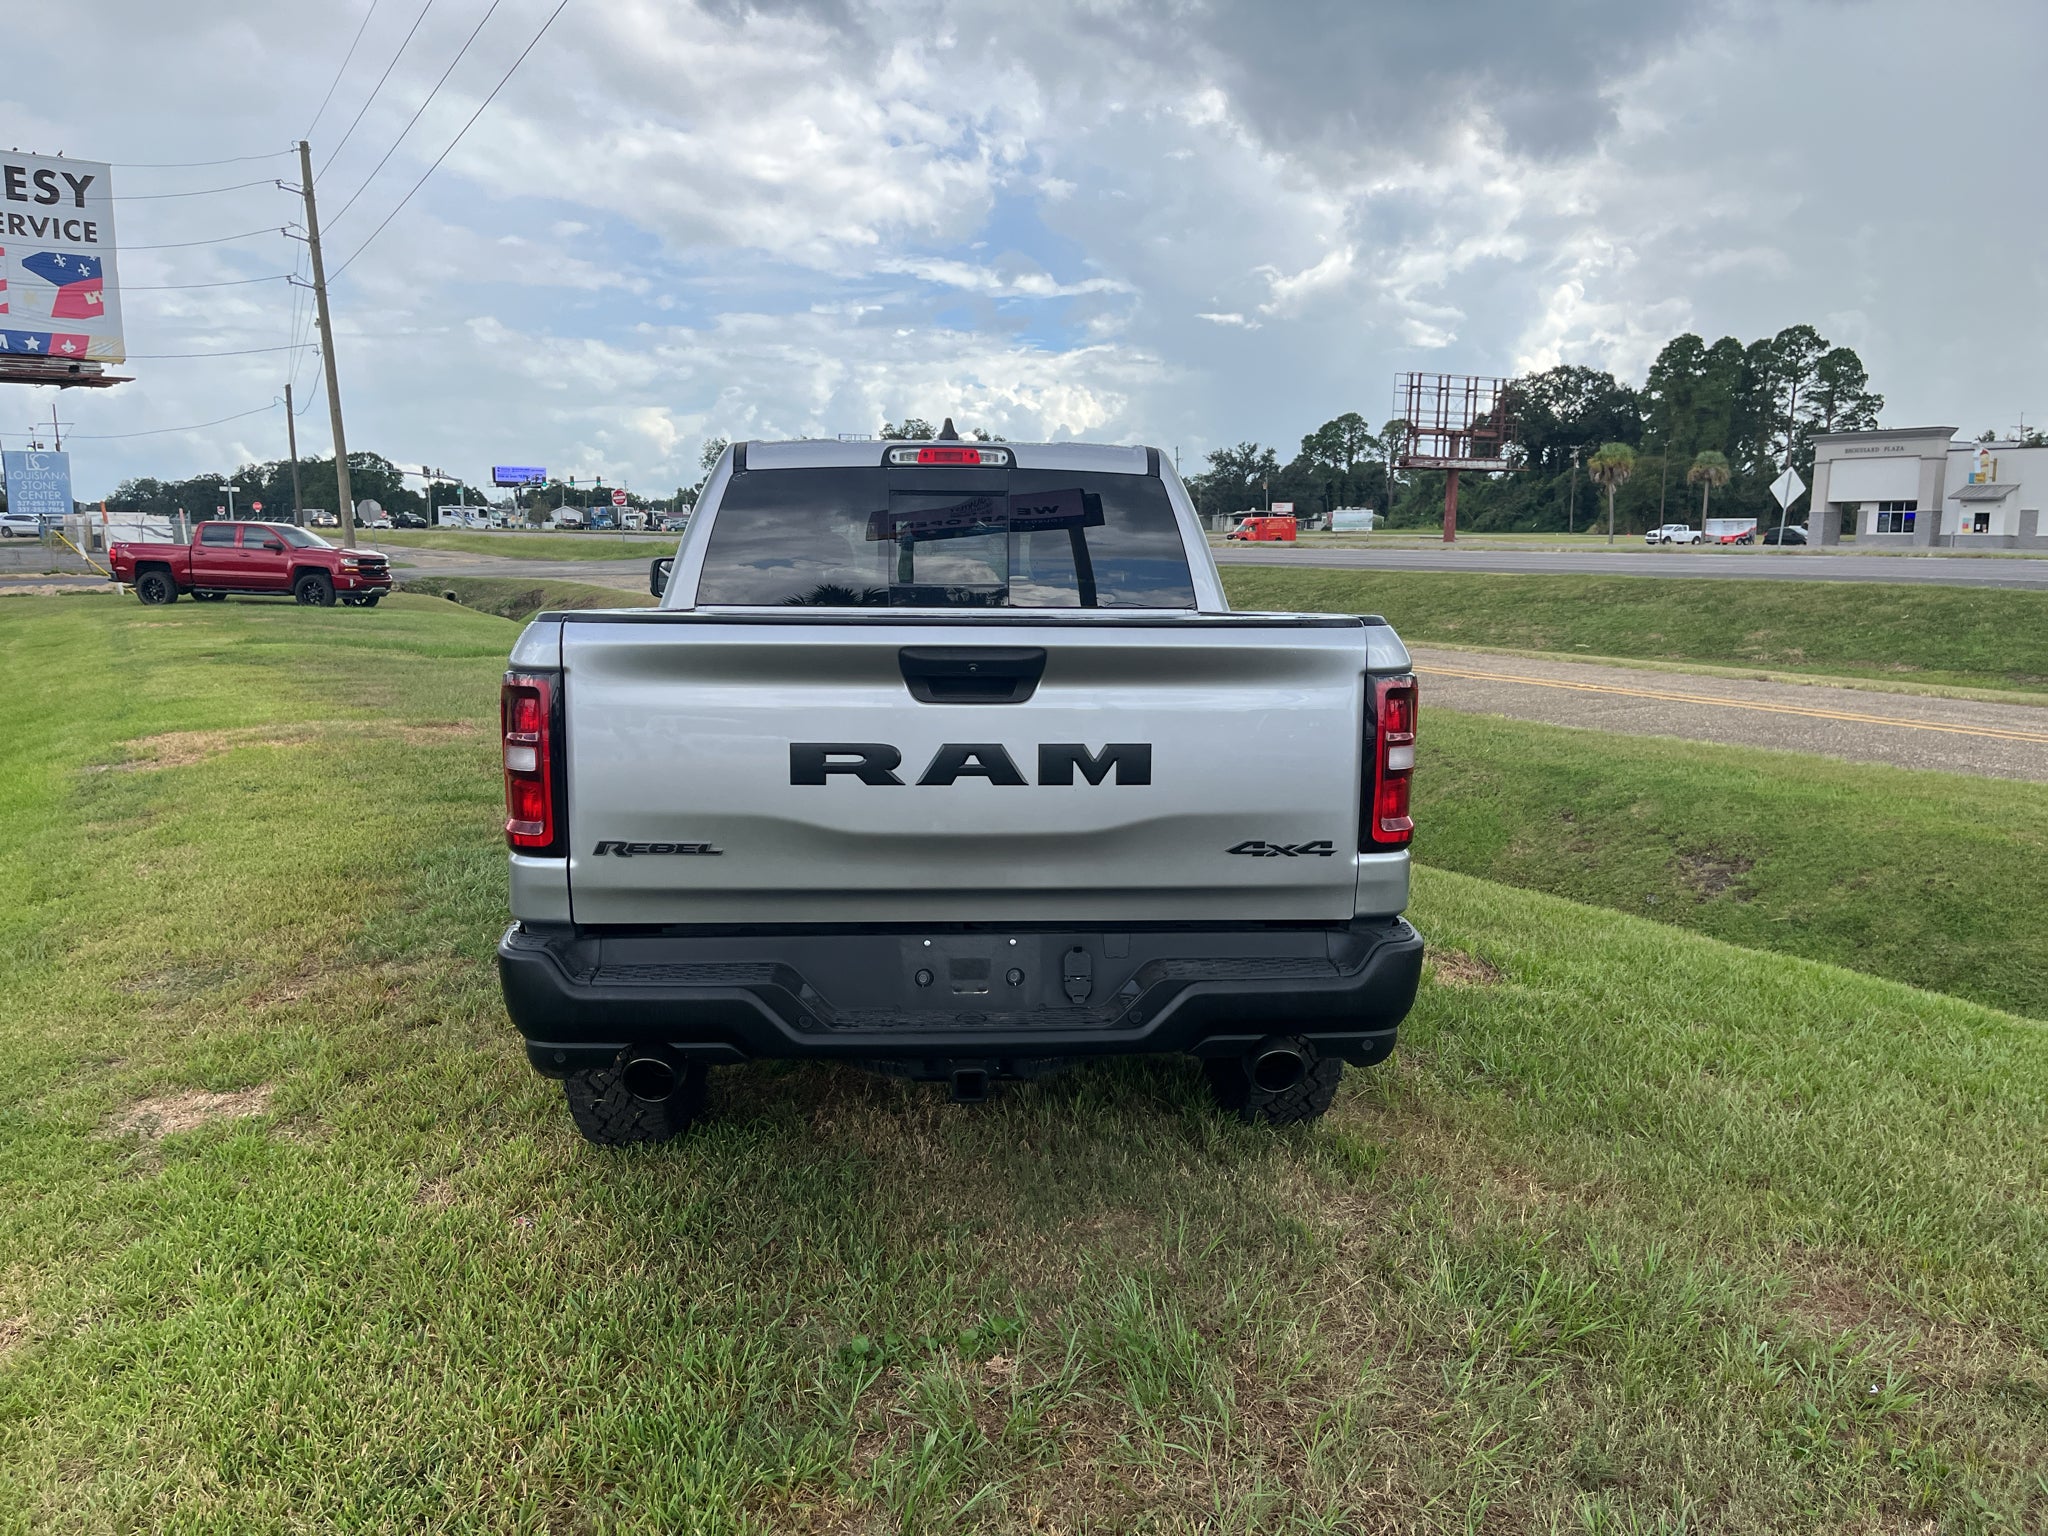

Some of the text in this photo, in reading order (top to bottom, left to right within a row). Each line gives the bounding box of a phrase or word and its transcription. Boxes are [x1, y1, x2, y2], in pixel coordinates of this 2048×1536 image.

[3, 164, 95, 208] ESY
[8, 470, 69, 480] LOUISIANA
[21, 480, 58, 490] STONE
[18, 490, 62, 500] CENTER
[790, 742, 1152, 786] RAM
[592, 841, 724, 858] REBEL
